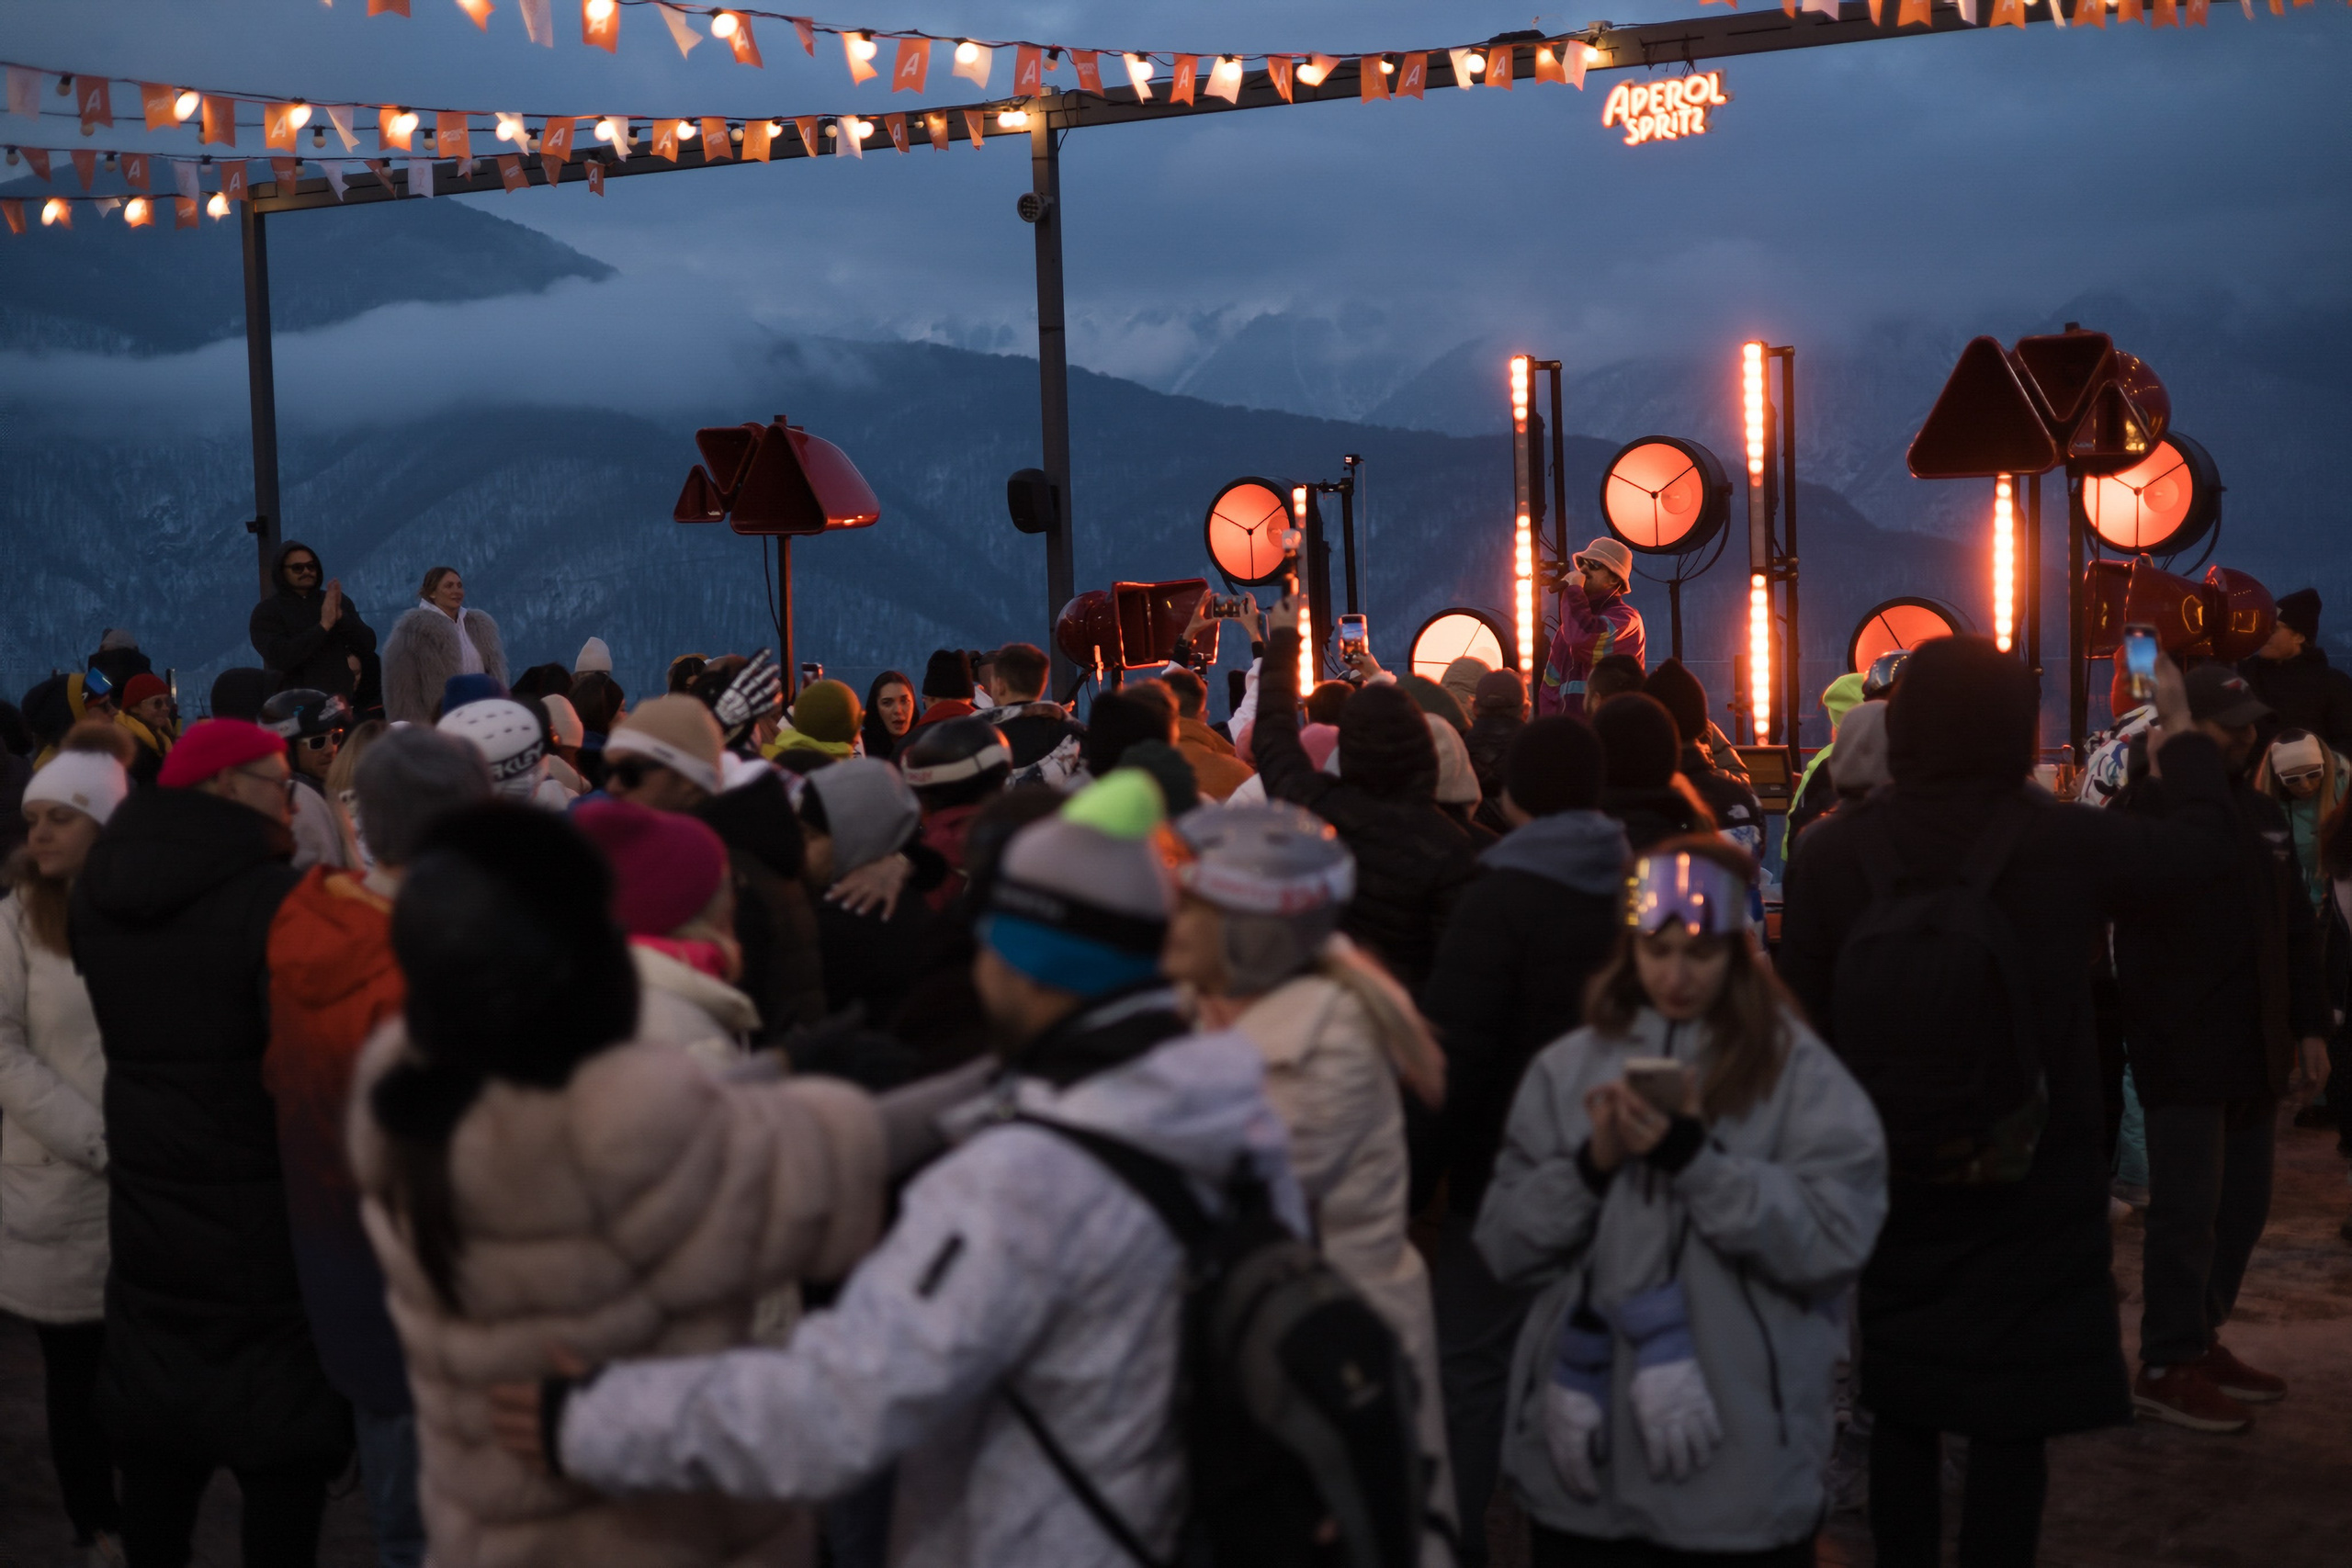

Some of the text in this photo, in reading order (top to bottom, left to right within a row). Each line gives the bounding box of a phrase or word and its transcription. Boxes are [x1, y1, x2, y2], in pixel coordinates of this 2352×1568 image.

[735, 26, 750, 51] A
[901, 52, 921, 77] A
[1021, 60, 1035, 85] A
[1405, 64, 1420, 87] A
[1492, 56, 1507, 78] A
[1178, 65, 1189, 88] A
[85, 89, 100, 113] A
[1601, 72, 1727, 128] APEROL
[271, 117, 287, 138] A
[548, 127, 565, 147] A
[658, 129, 672, 150] A
[128, 160, 141, 179] A
[589, 167, 597, 185] A
[230, 172, 240, 191] A
[491, 740, 544, 780] AKLEY
